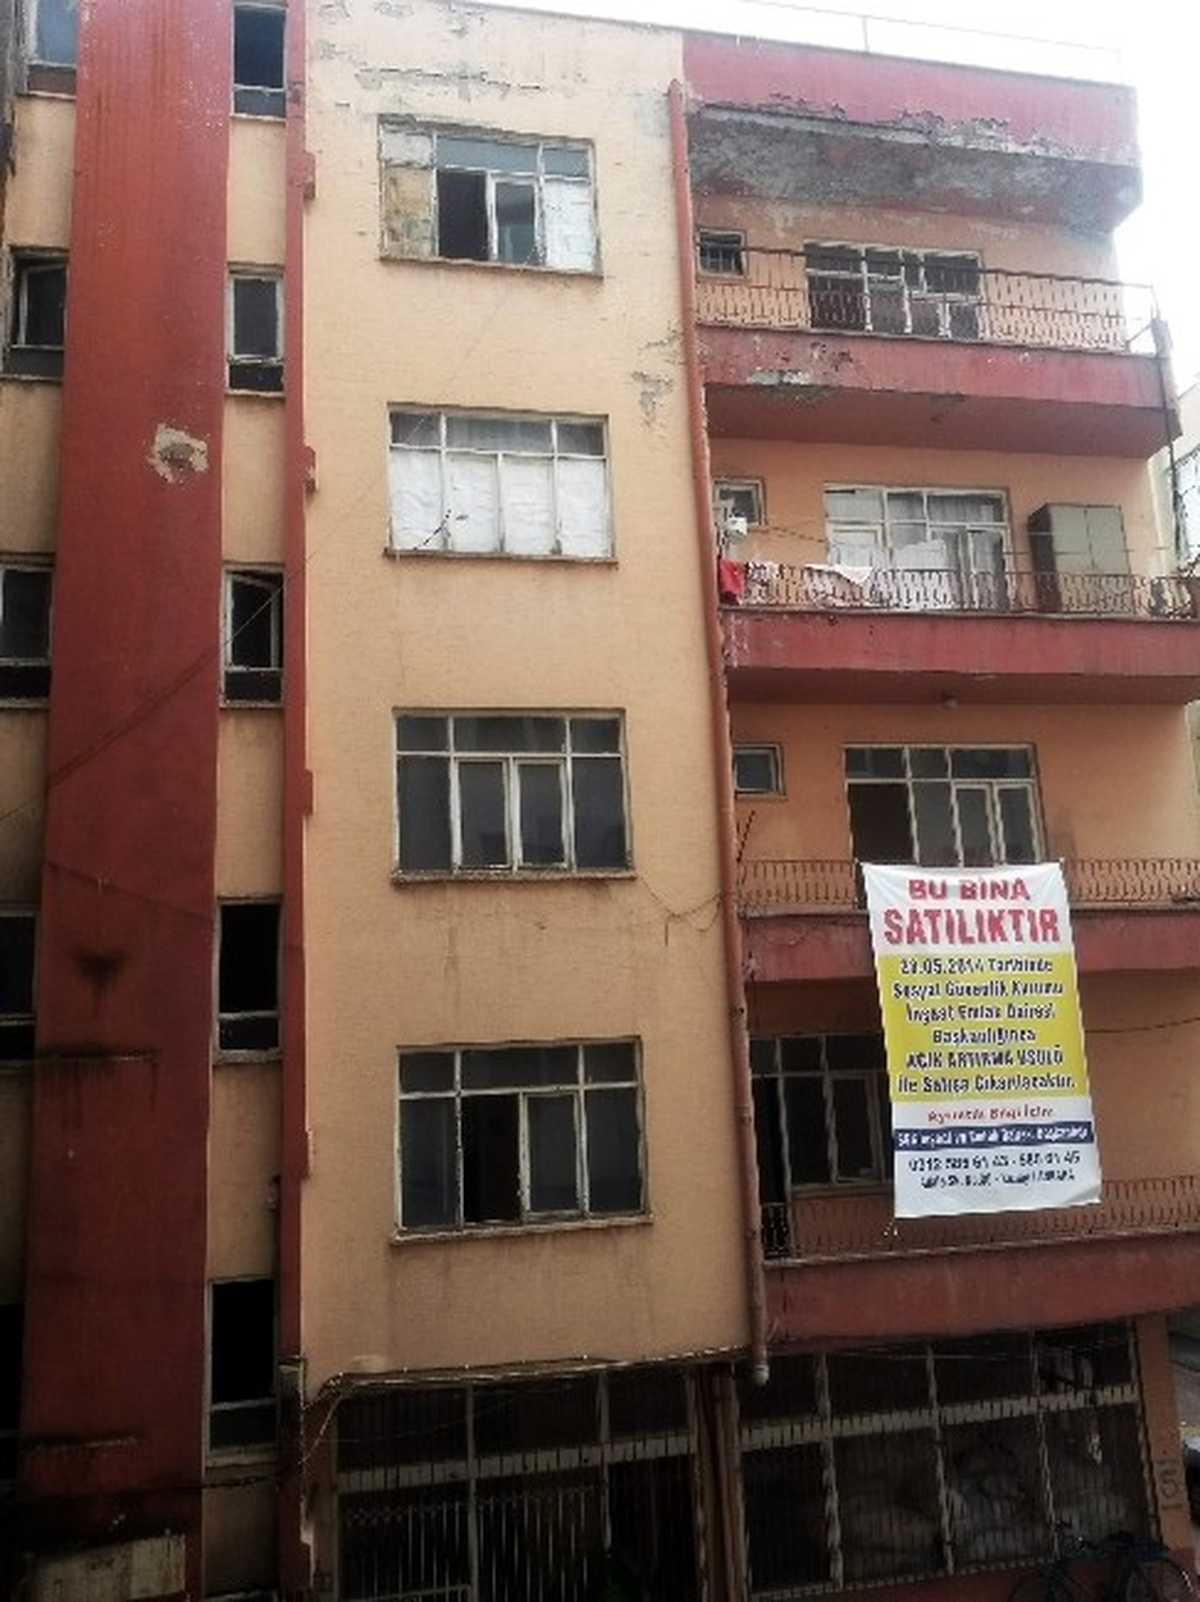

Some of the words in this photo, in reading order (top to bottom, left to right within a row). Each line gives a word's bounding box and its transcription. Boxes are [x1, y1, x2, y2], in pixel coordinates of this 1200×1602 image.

[908, 879, 947, 899] BU
[959, 877, 1031, 900] BİNA
[883, 908, 1060, 945] SATILIKTIR
[893, 982, 940, 1000] Sosyal
[945, 981, 1008, 998] Güvenlik
